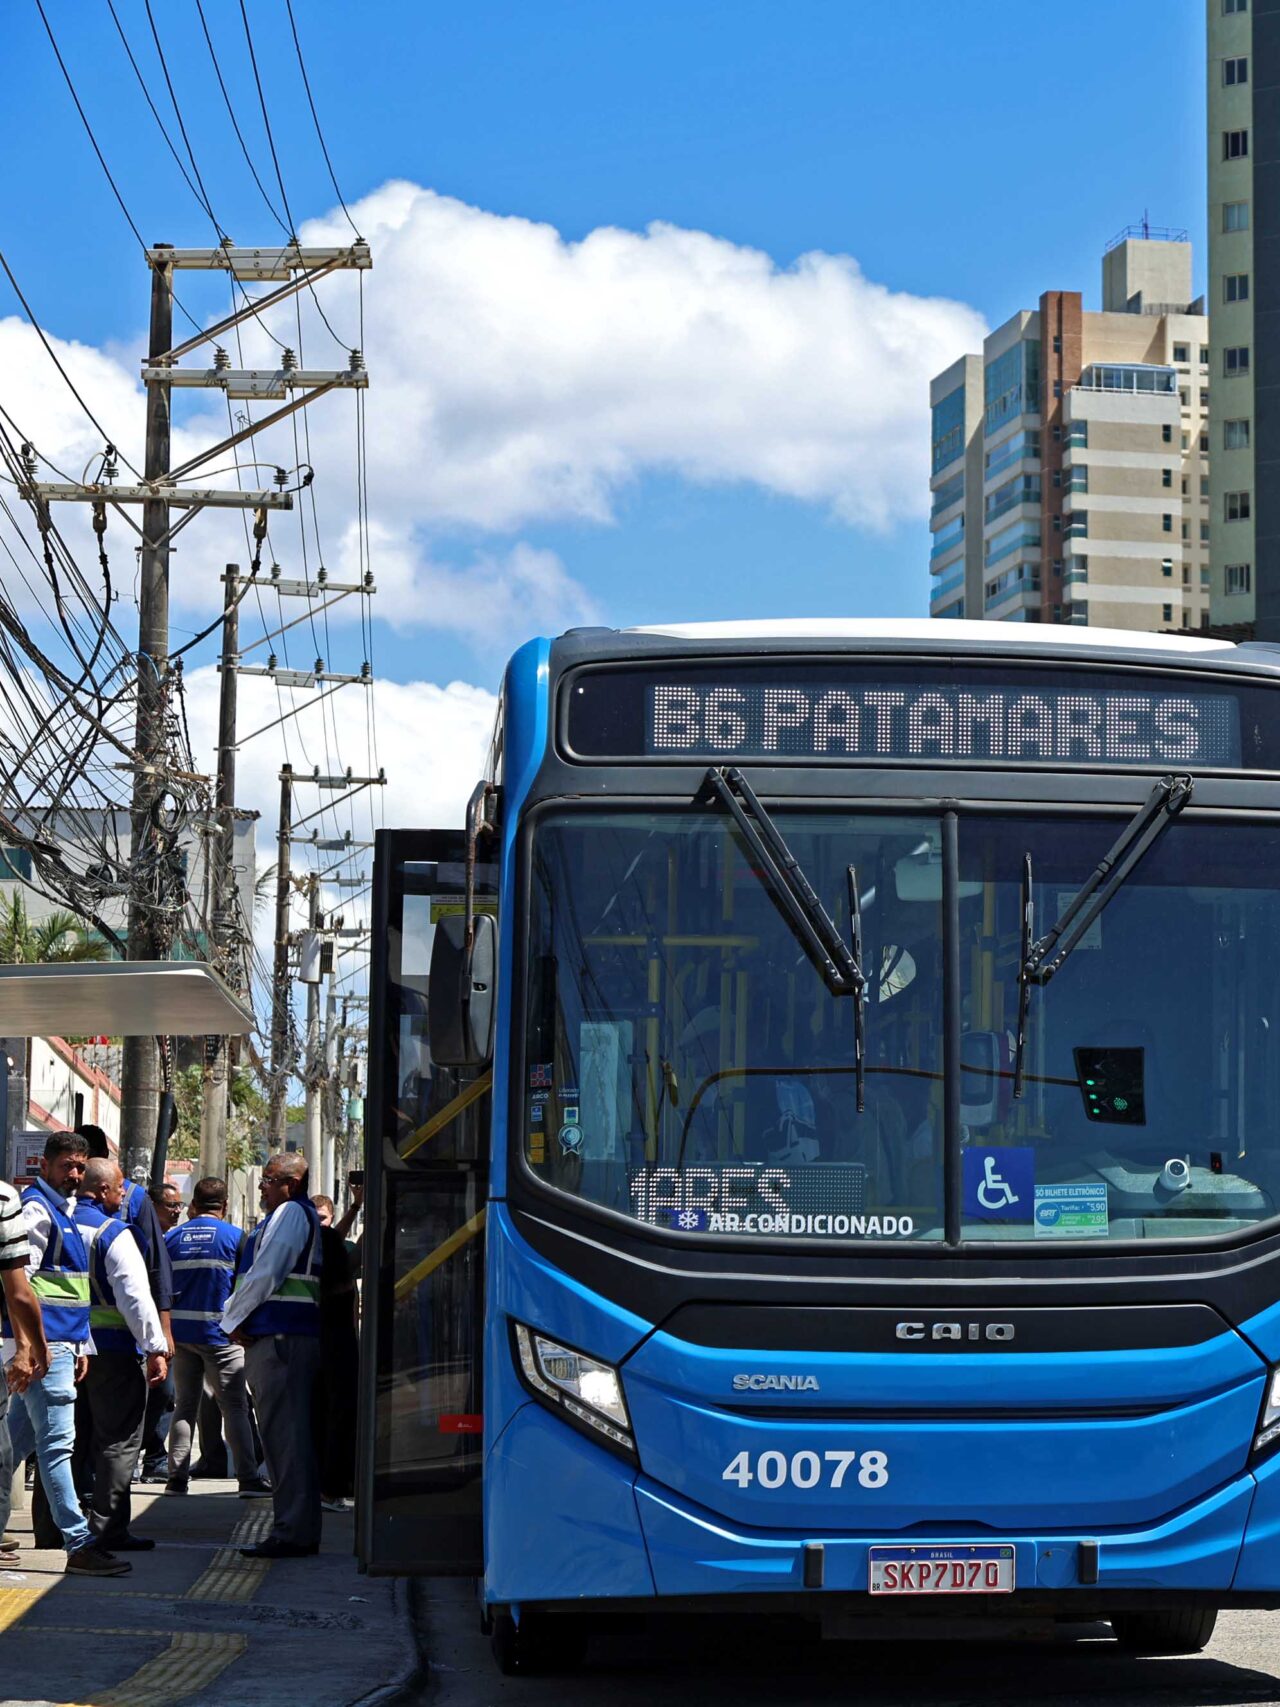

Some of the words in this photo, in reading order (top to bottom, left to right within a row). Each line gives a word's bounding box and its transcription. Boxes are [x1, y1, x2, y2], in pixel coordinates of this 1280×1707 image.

[653, 686, 746, 749] B6
[763, 689, 1199, 758] PATAMARES
[1045, 1188, 1068, 1197] BILHETE
[1069, 1186, 1104, 1196] ELETRÔNICO
[708, 1213, 742, 1231] AR
[744, 1213, 914, 1235] CONDICIONADO
[895, 1322, 1015, 1341] CAIO
[733, 1374, 820, 1391] SCANIA
[722, 1451, 889, 1489] 40078
[930, 1551, 954, 1559] BRASIL
[883, 1561, 1000, 1590] SKP7D70
[872, 1583, 881, 1592] BR
